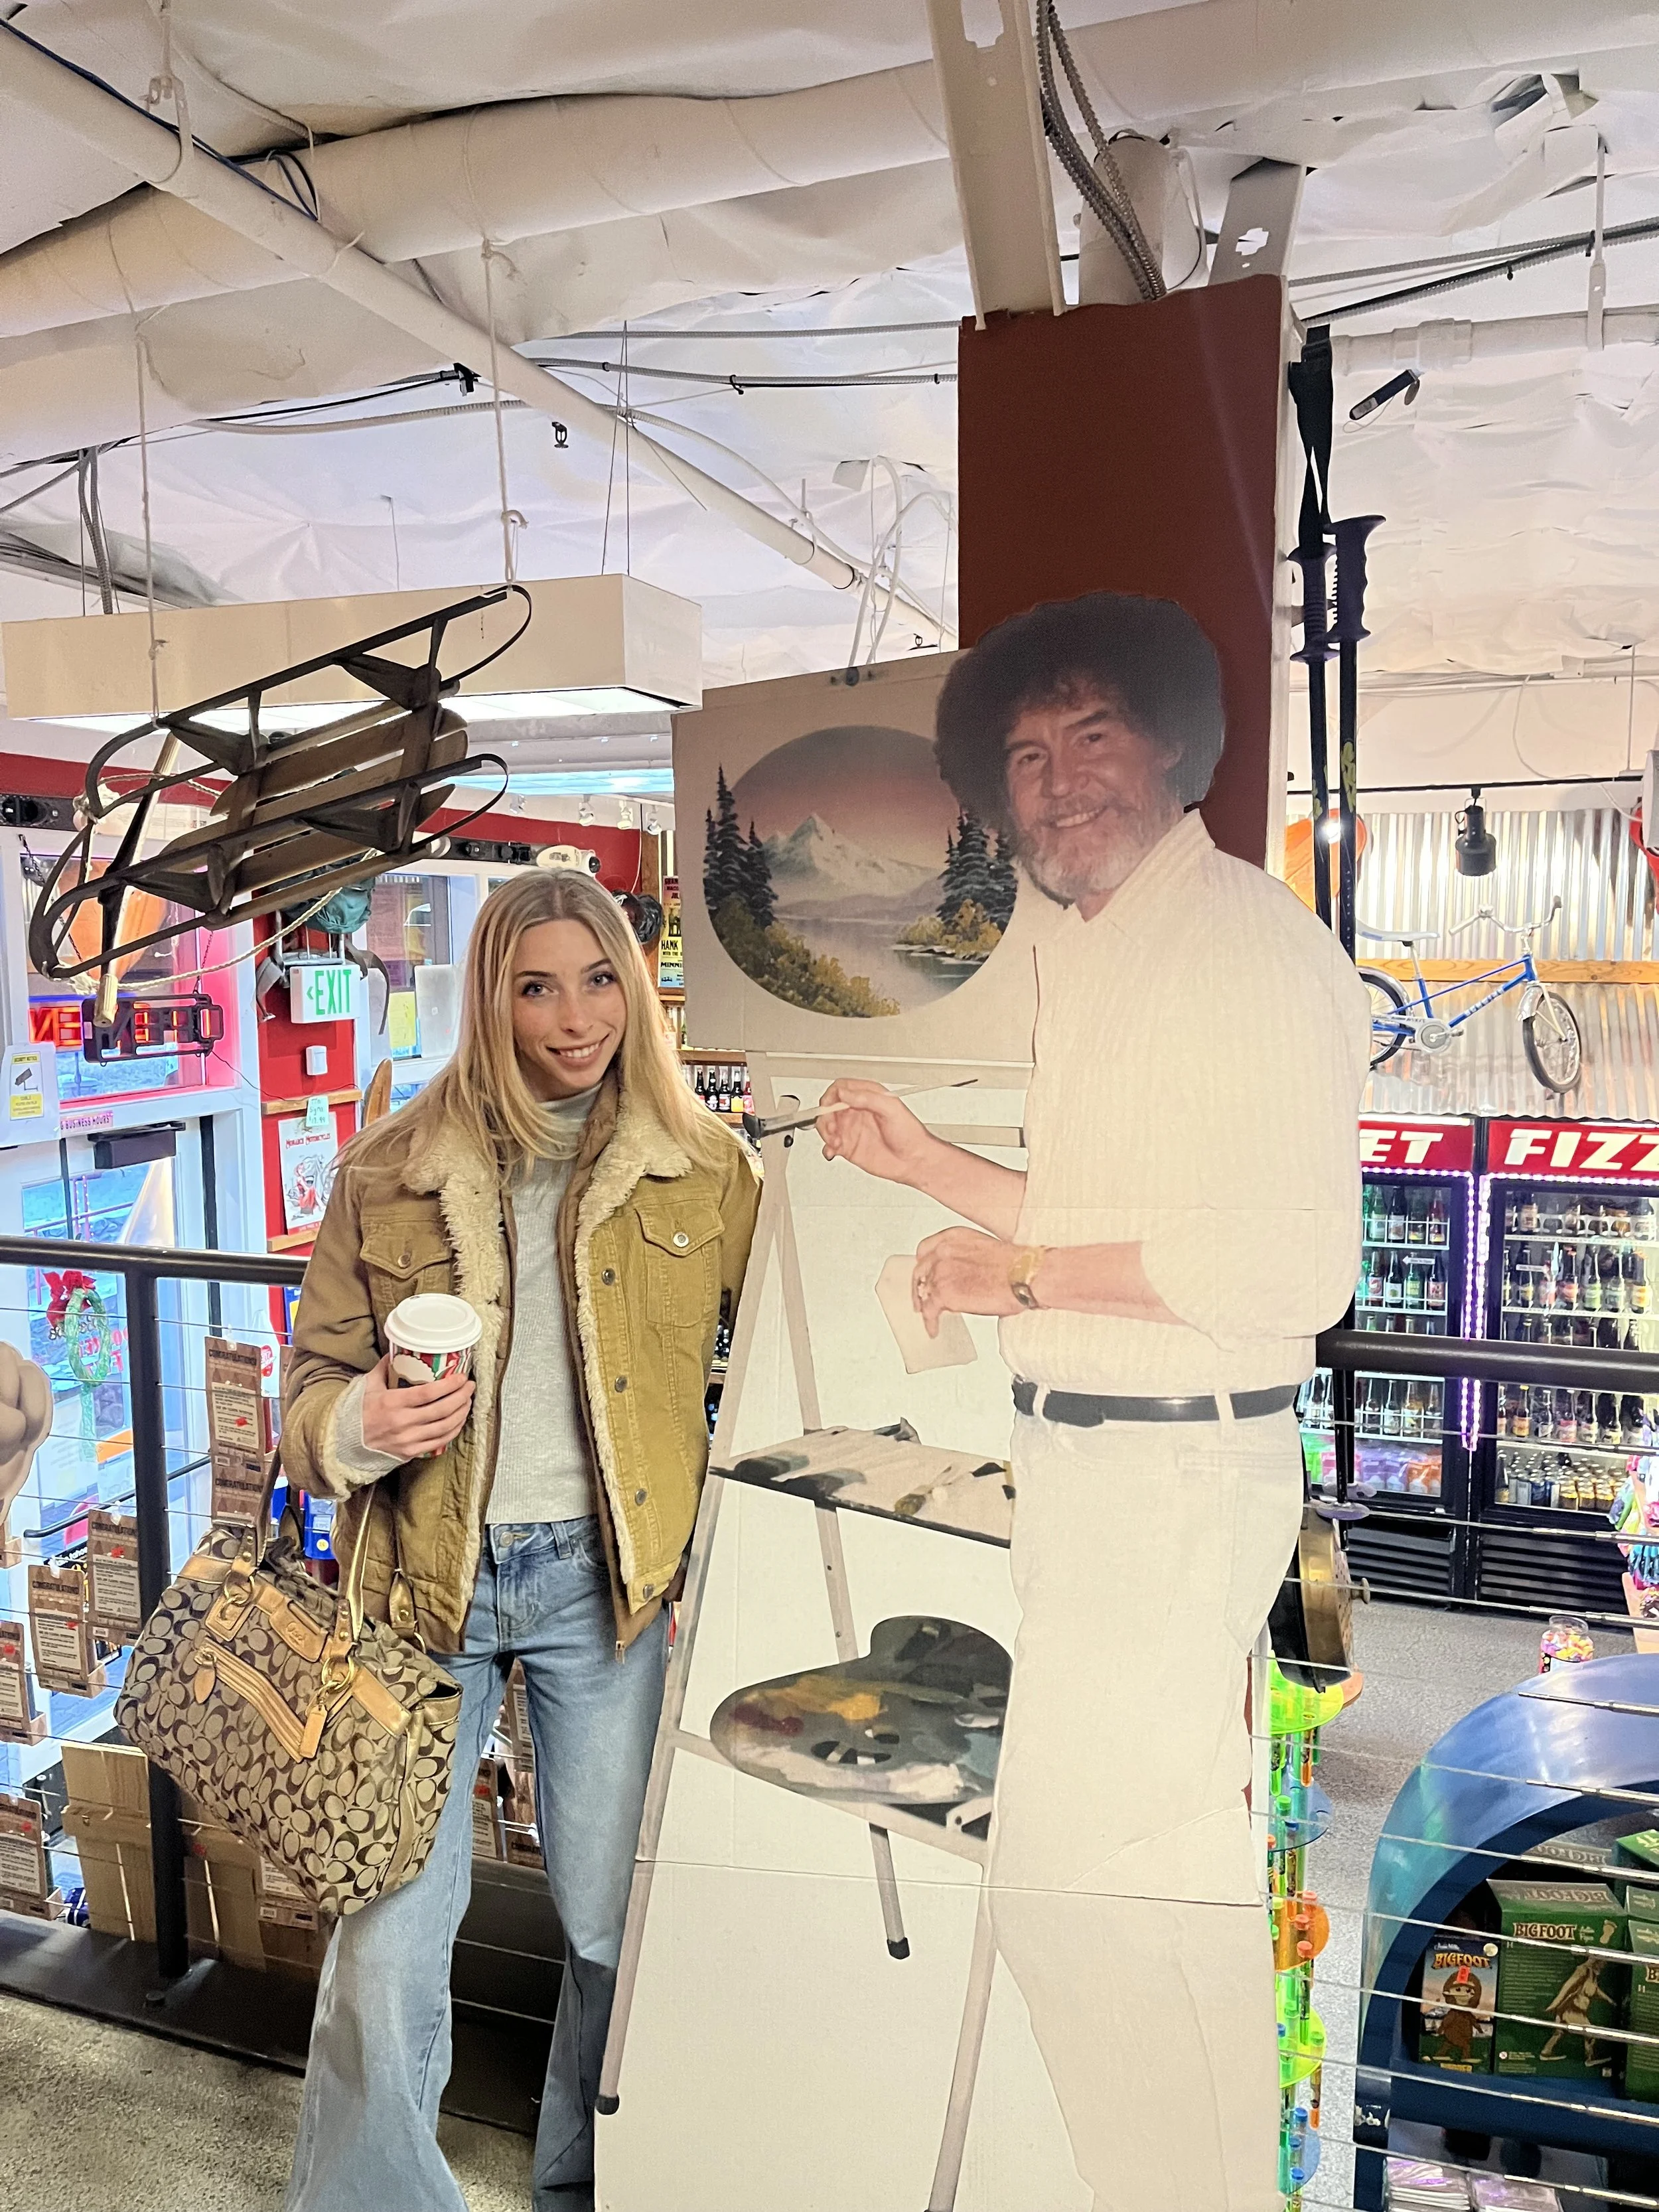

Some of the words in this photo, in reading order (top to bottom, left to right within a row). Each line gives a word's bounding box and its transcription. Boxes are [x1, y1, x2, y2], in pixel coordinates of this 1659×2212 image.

[661, 940, 678, 950] HANK
[315, 969, 352, 1015] EXIT
[65, 1116, 92, 1130] BUSINESS
[92, 1114, 110, 1126] HOURS
[1360, 1128, 1444, 1164] ET
[1525, 1889, 1608, 1903] BIGFOOT
[1514, 1923, 1575, 1939] BIGFOOT
[1433, 1952, 1492, 1970] BIGFOOT
